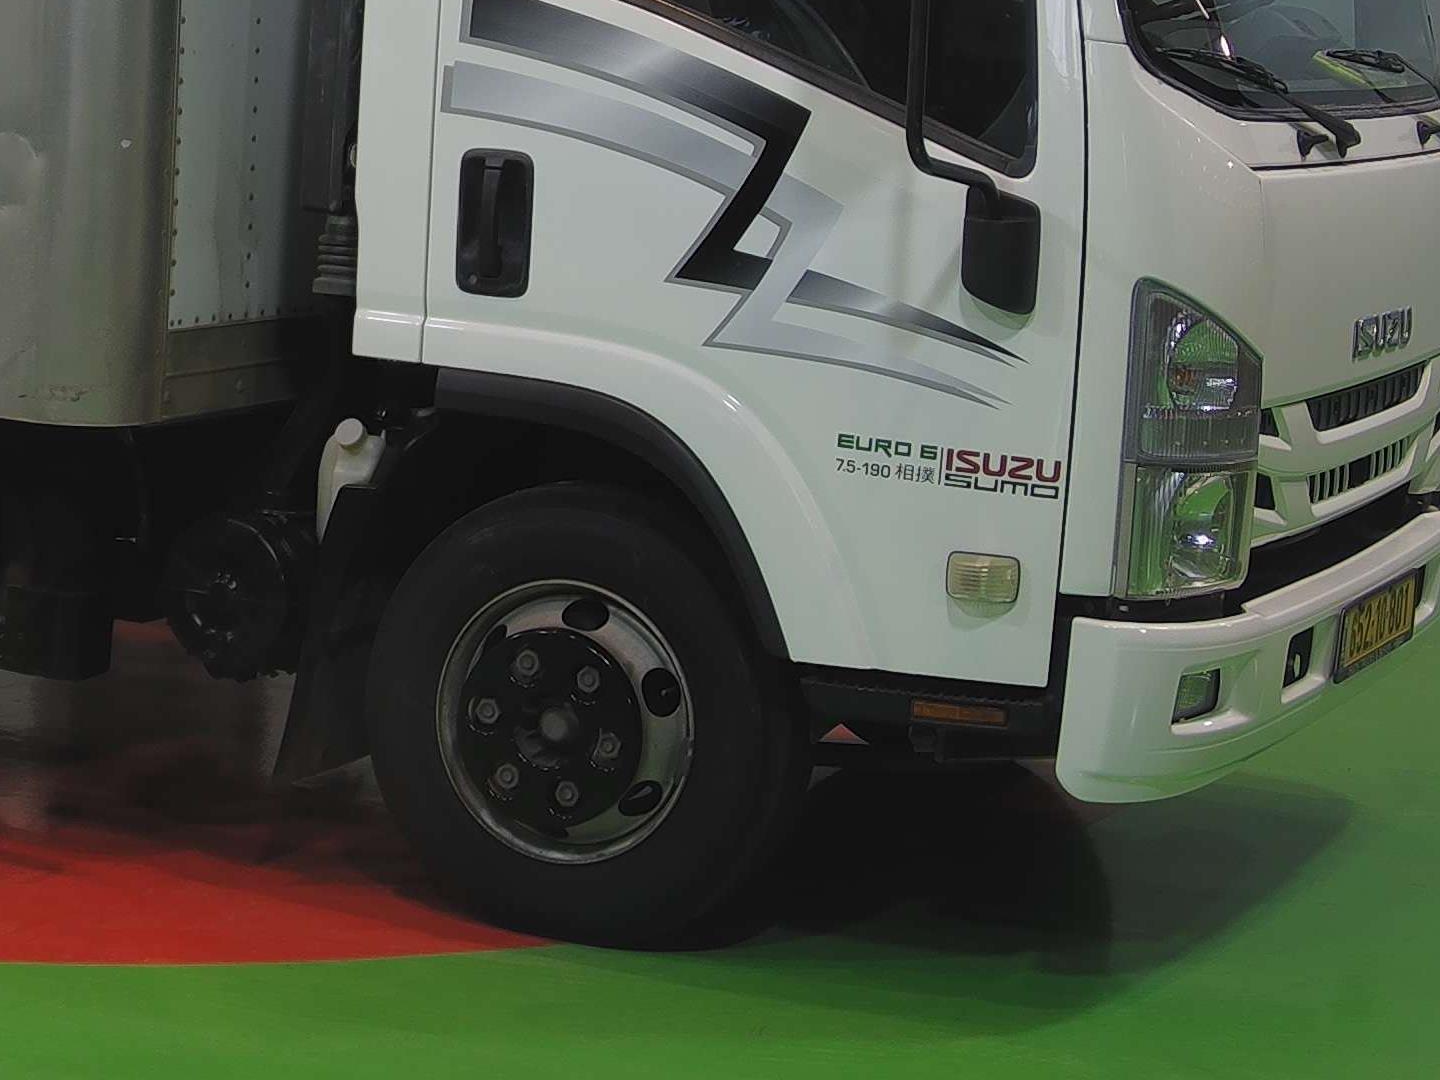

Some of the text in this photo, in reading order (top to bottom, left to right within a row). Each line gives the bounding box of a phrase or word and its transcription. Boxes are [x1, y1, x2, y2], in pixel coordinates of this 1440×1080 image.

[1352, 313, 1412, 359] ISUZU
[837, 433, 939, 461] EURO 6
[835, 457, 892, 479] 7.5-190
[945, 448, 1062, 483] ISUZU
[943, 472, 1060, 500] SUMO
